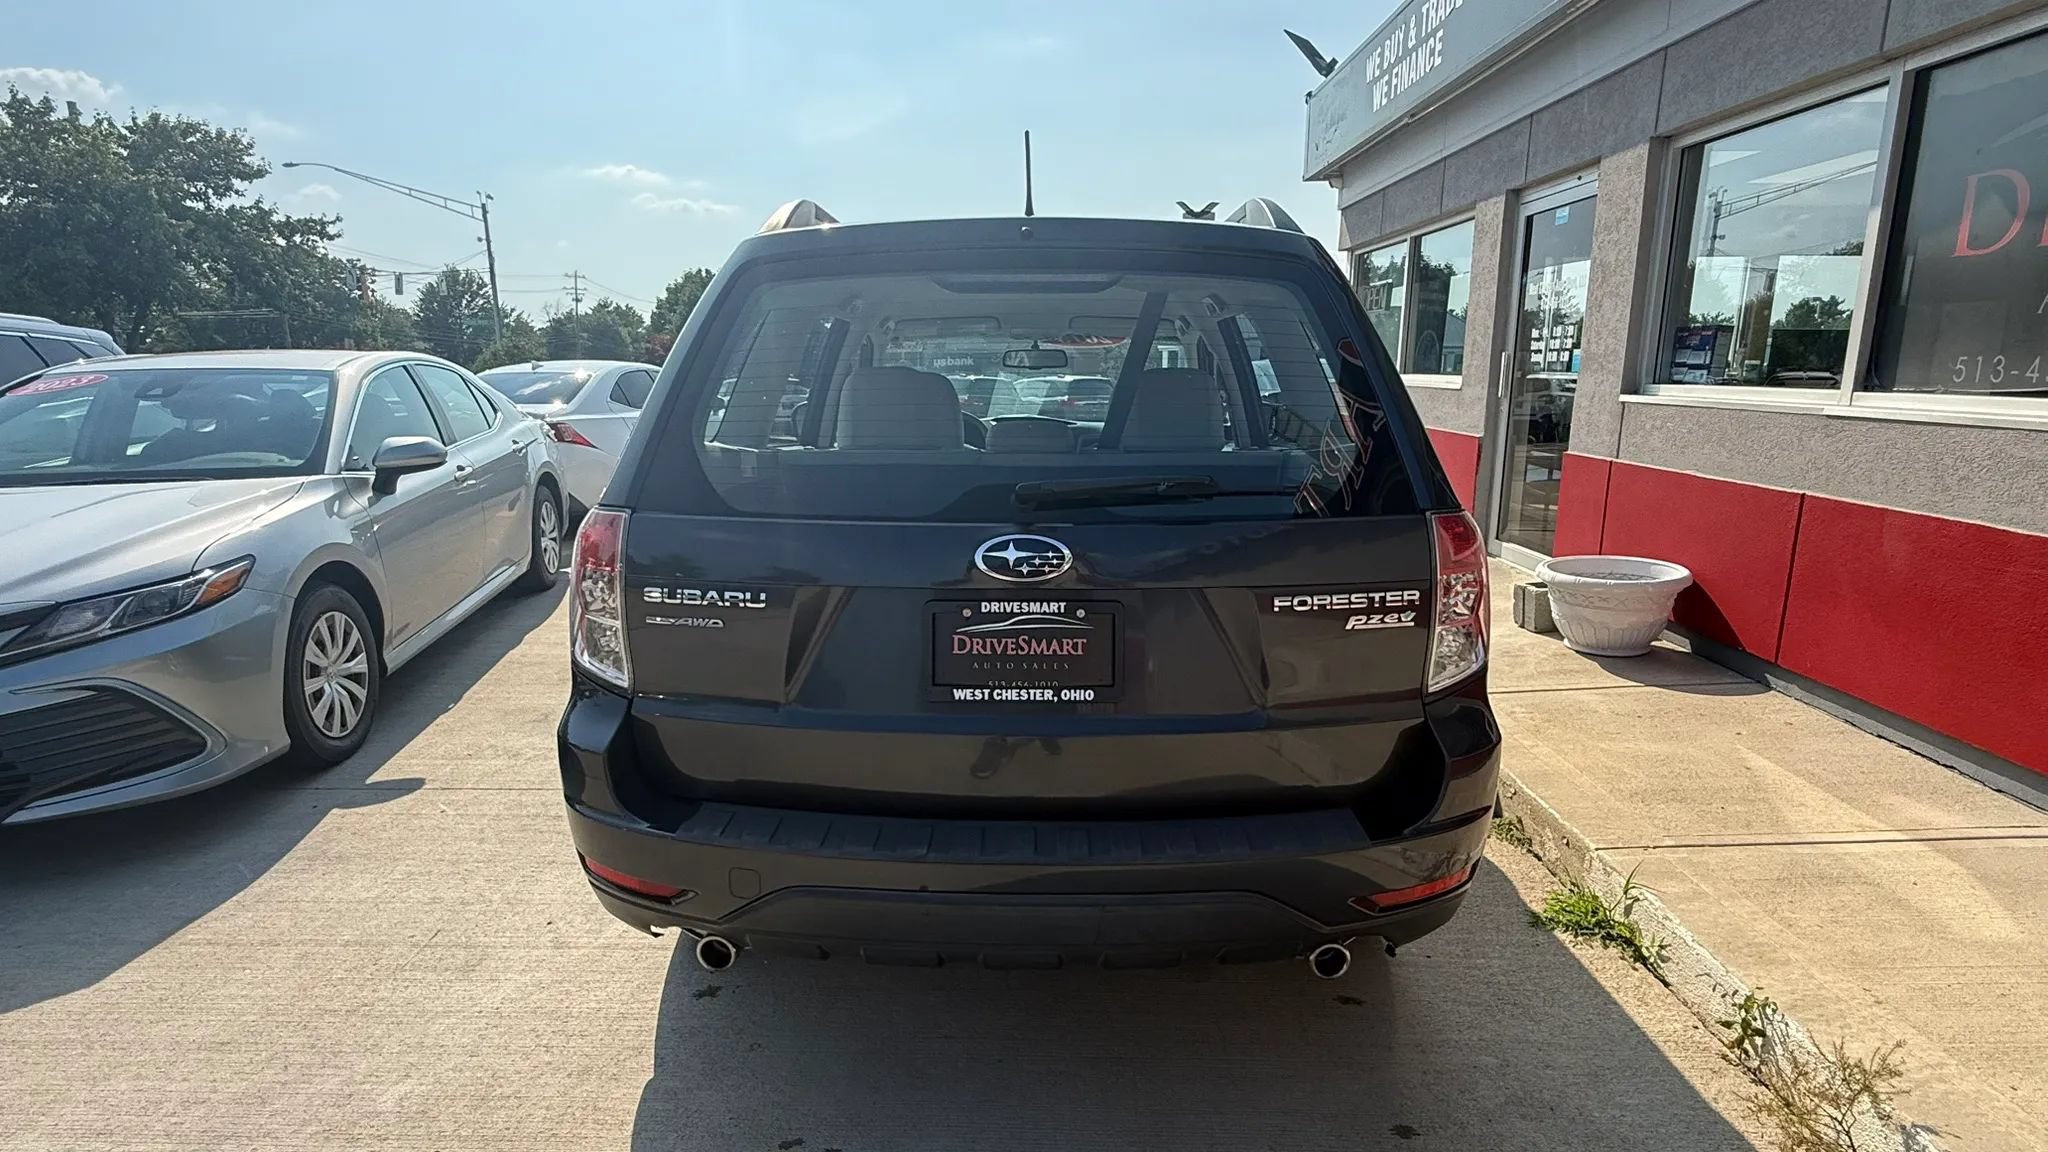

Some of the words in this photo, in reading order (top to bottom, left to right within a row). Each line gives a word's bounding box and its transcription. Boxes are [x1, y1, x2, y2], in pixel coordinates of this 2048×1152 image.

[1366, 46, 1381, 84] WE
[1383, 24, 1406, 70] BUY
[1408, 14, 1417, 49] &
[1373, 74, 1389, 113] WE
[1390, 28, 1443, 100] FINANCE
[1952, 168, 2048, 258] D
[1952, 355, 2048, 384] 513-4
[643, 586, 766, 608] SUBARU
[981, 602, 1067, 613] DRIVESMART
[1273, 590, 1420, 612] FORESTER
[972, 662, 1014, 670] AUTO
[1022, 662, 1070, 670] SALES
[953, 689, 990, 701] WEST
[993, 689, 1058, 702] CHESTER,
[1061, 689, 1095, 701] OHIO
